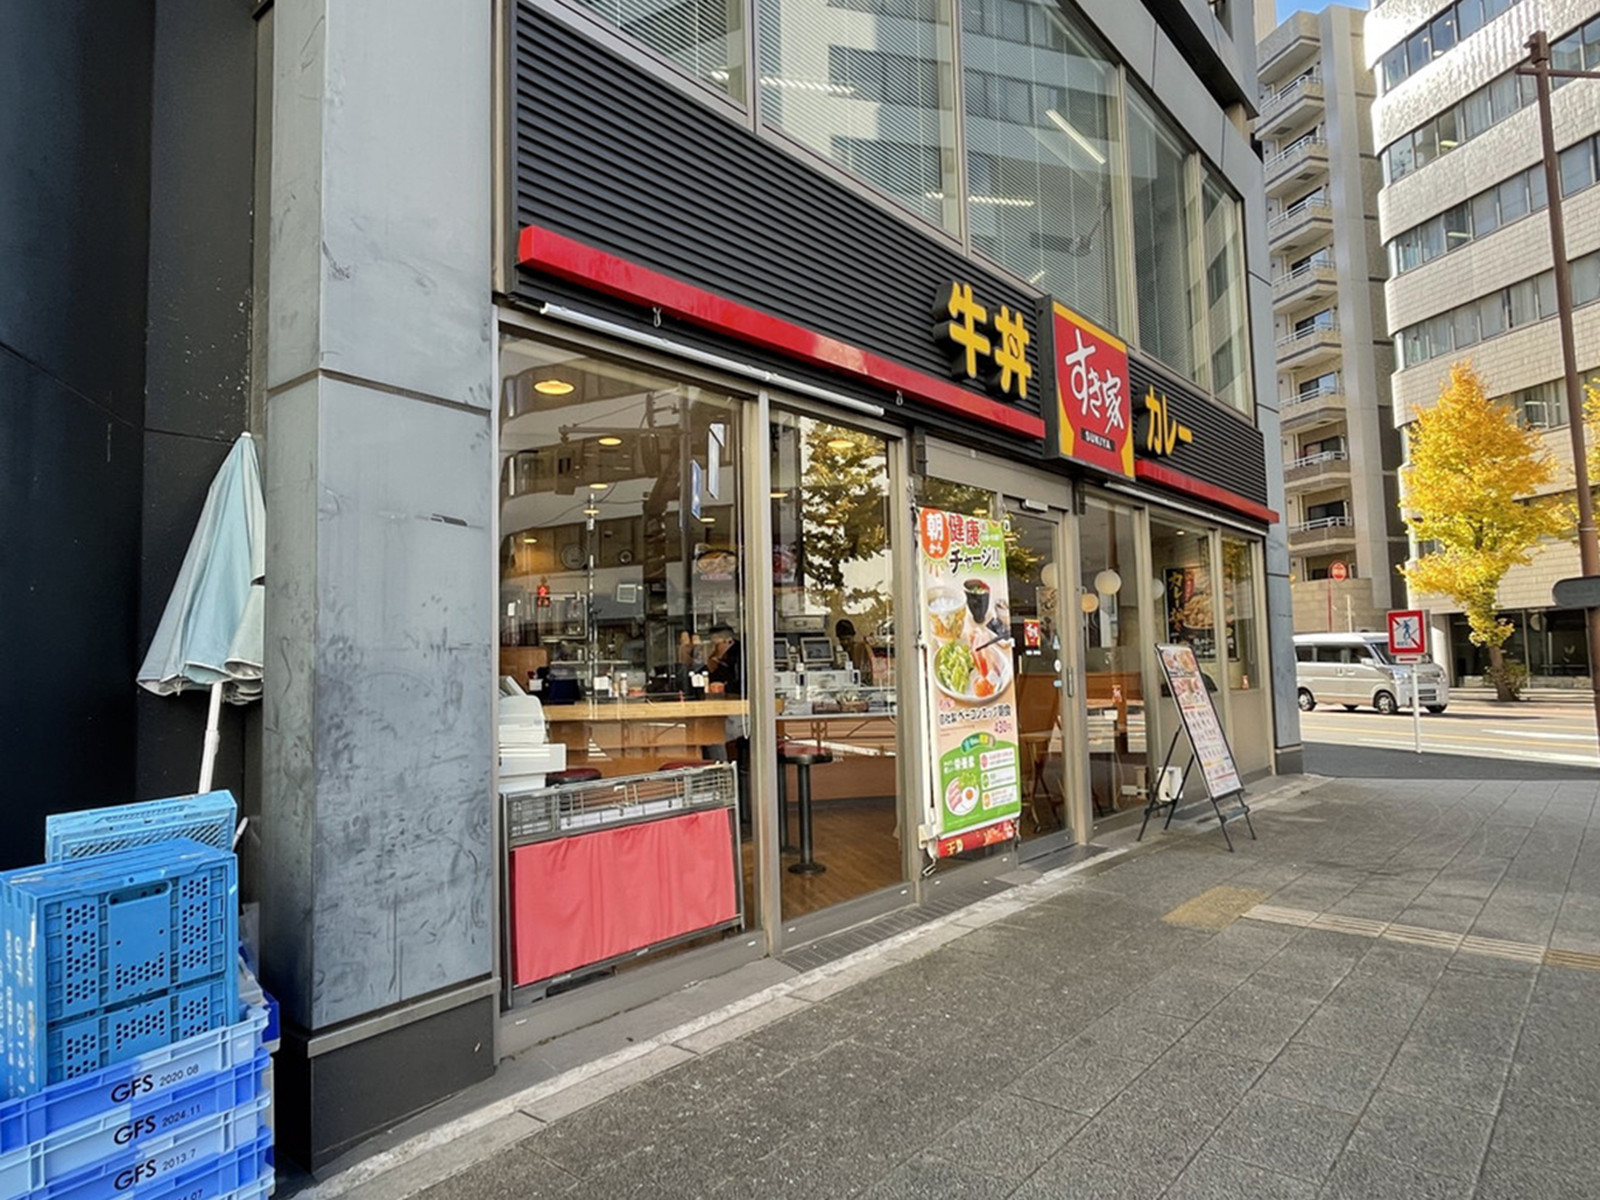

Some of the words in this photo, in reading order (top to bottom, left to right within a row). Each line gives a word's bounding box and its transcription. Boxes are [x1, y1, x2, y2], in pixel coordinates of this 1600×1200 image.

[948, 280, 1032, 400] 牛丼
[1065, 328, 1125, 434] すき家
[1085, 430, 1112, 450] SUKIYA
[1145, 384, 1193, 455] カレー
[948, 514, 981, 548] 健康
[111, 1074, 154, 1102] GFS
[159, 1064, 199, 1087] 2020.08
[114, 1115, 156, 1144] GFS
[162, 1104, 201, 1127] 2024.11
[114, 1159, 157, 1190] GFS
[162, 1148, 196, 1171] 2013.7
